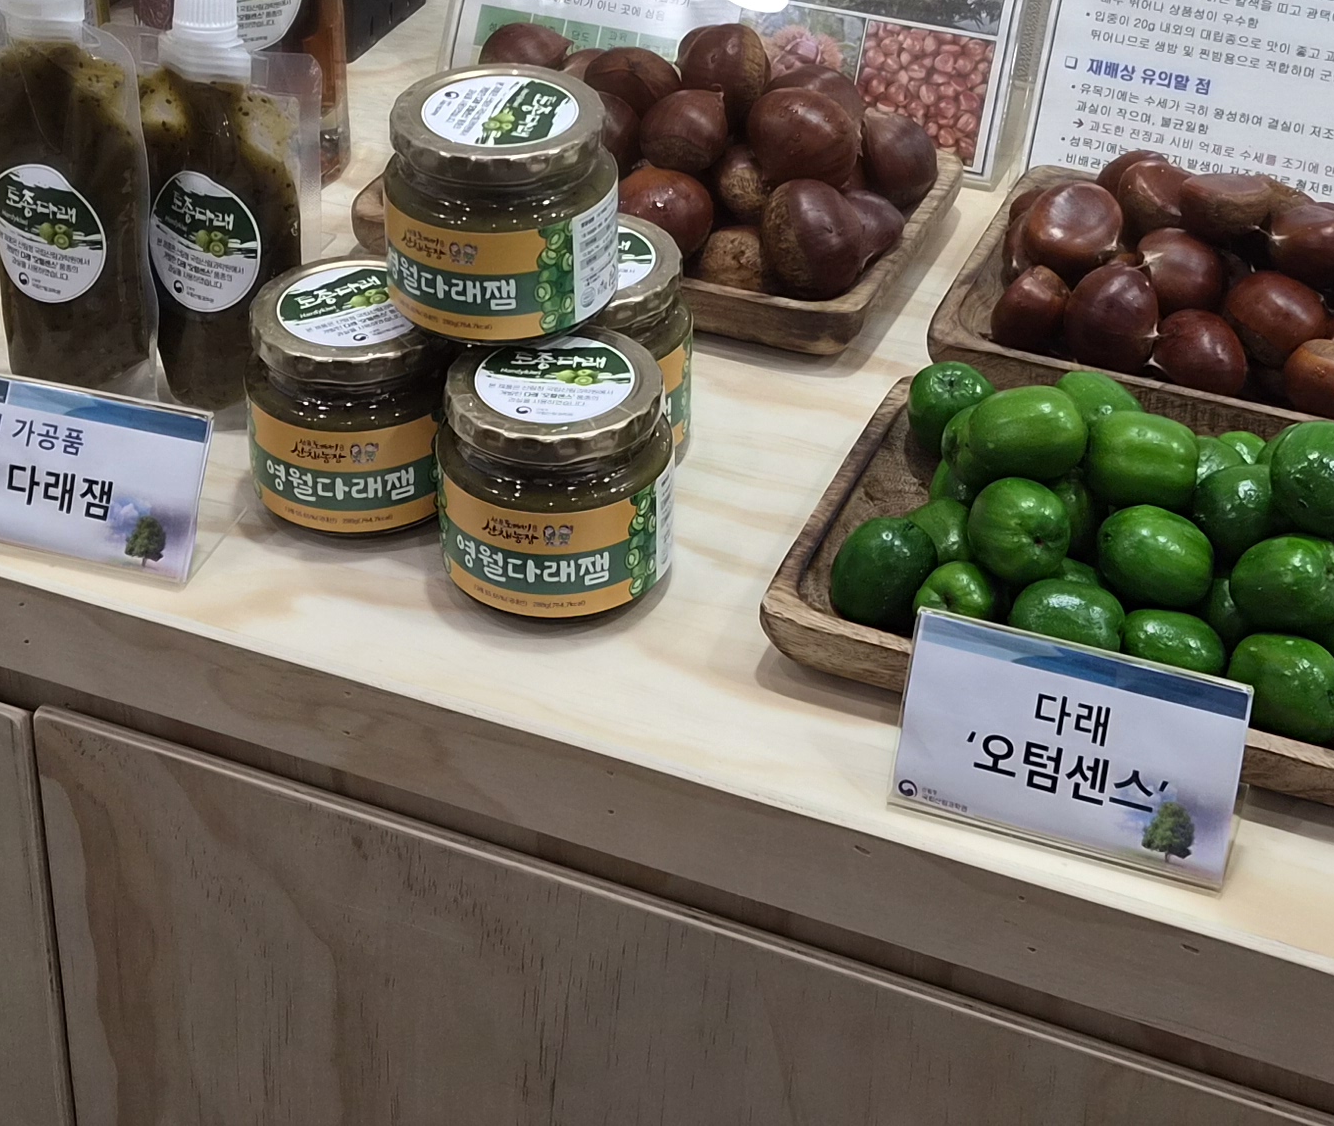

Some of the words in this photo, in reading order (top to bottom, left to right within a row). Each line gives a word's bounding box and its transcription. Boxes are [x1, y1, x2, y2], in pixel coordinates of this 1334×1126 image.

[1094, 10, 1130, 27] 입중이
[1133, 17, 1156, 32] 20g
[1159, 21, 1196, 38] 내외의
[1199, 28, 1262, 50] 대립종으로
[1266, 40, 1291, 55] 맛이
[1169, 4, 1218, 23] 상품성이
[1222, 13, 1259, 29] 우수함
[1086, 58, 1136, 82] 재배상
[1140, 68, 1191, 92] 유의할
[1195, 77, 1211, 96] 점
[6, 185, 77, 225] 토종다래
[171, 190, 234, 232] 토종다래
[294, 275, 382, 310] 토종다래
[388, 246, 517, 311] 영월다래잼
[510, 351, 607, 370] 토종다래
[11, 417, 85, 457] 가공품
[6, 463, 114, 522] 다래잼
[266, 459, 415, 501] 영월다래잼
[456, 534, 610, 586] 영월다래잼
[1034, 692, 1112, 747] 다래
